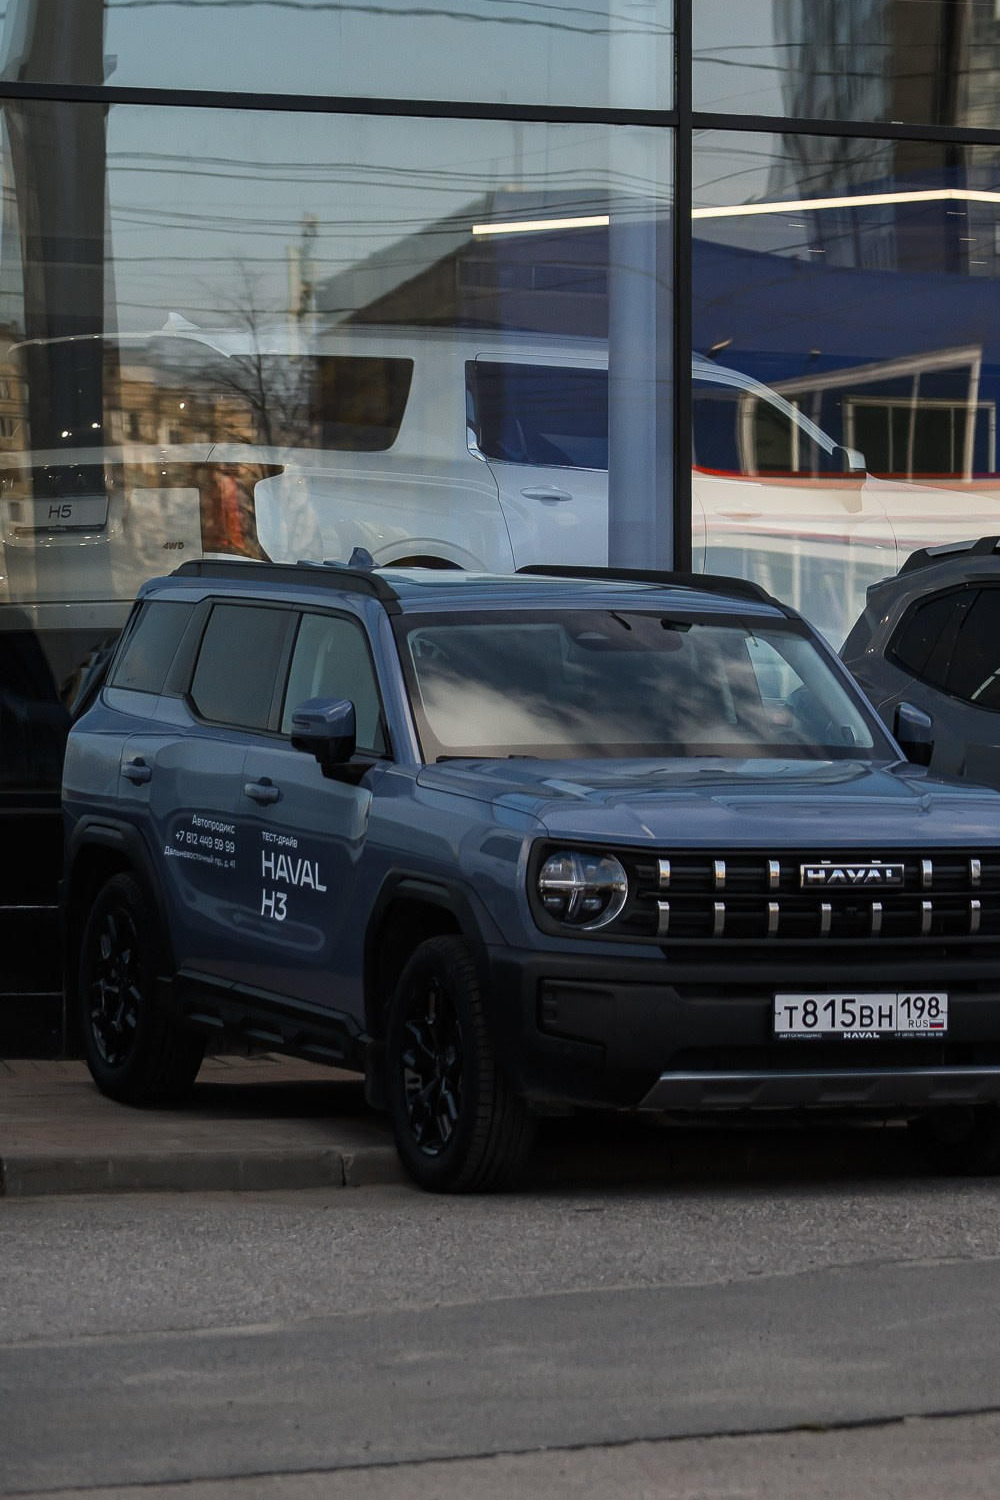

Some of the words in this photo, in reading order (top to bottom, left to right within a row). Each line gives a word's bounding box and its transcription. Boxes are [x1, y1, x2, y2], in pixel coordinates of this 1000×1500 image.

[49, 504, 72, 519] H5
[162, 541, 185, 550] 4WD
[192, 815, 235, 834] Автопродикс
[176, 831, 185, 842] +7
[186, 832, 198, 845] 812
[225, 841, 235, 853] 99
[262, 831, 298, 848] ТЕСТ-ДРАЙВ
[261, 850, 328, 892] HAVAL
[807, 869, 901, 883] HAVAL
[260, 888, 288, 921] H3
[784, 999, 893, 1029] Т815ВН
[900, 996, 941, 1019] 198
[908, 1019, 929, 1028] RUS
